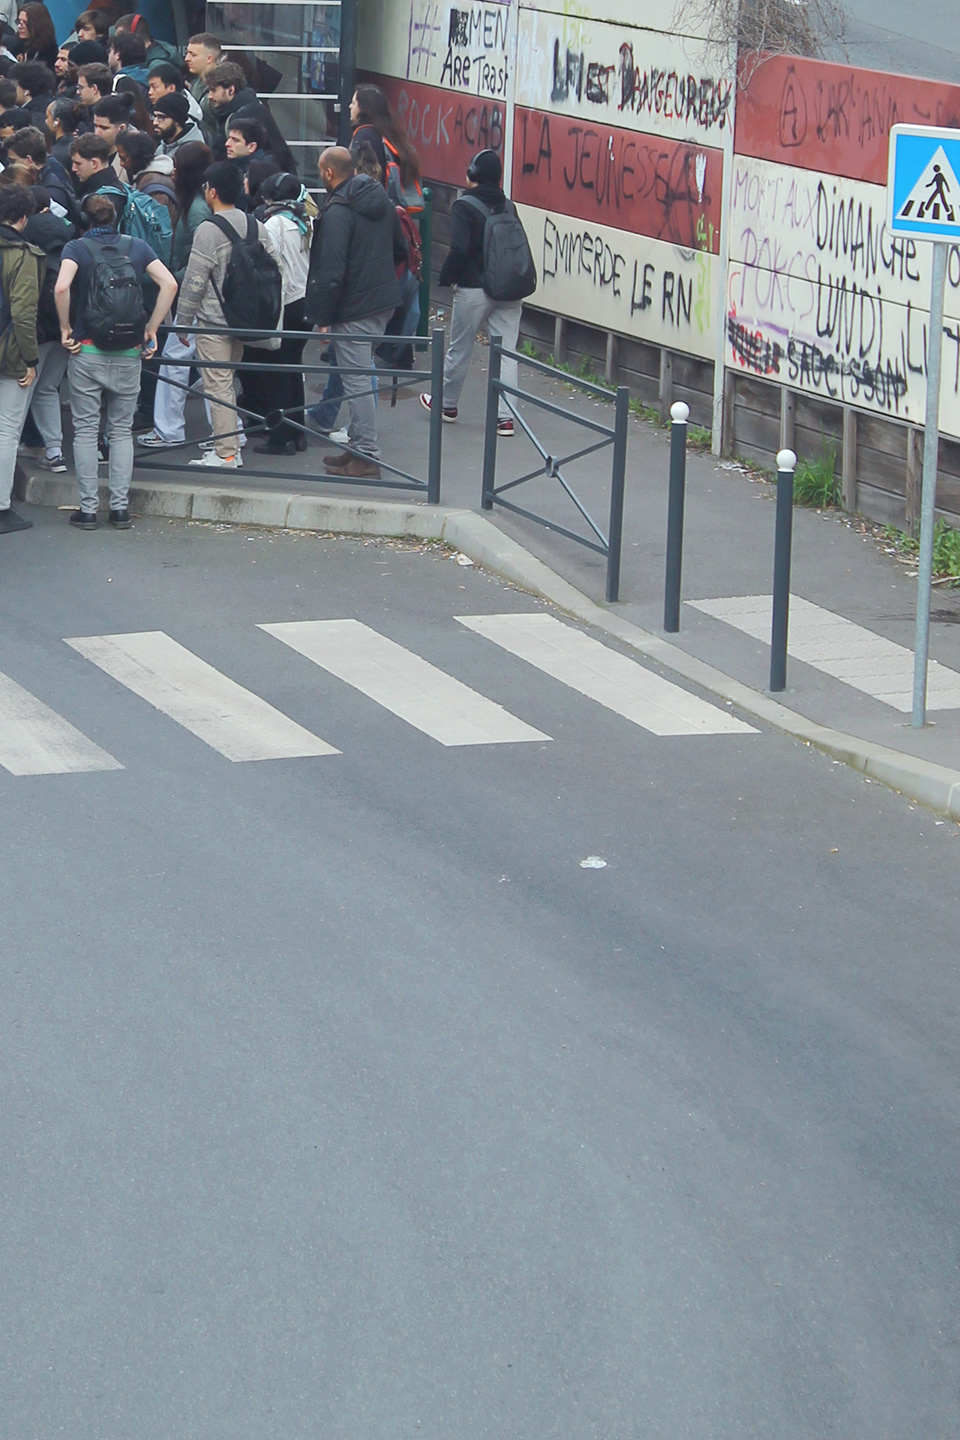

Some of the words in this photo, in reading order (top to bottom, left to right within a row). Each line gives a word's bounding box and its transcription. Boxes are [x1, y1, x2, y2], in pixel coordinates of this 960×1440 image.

[453, 103, 504, 152] ACAB
[521, 114, 552, 182] LA
[563, 126, 670, 209] JEUNESSE
[542, 216, 626, 298] EMMERDE
[630, 260, 655, 317] LE
[662, 270, 693, 328] RN
